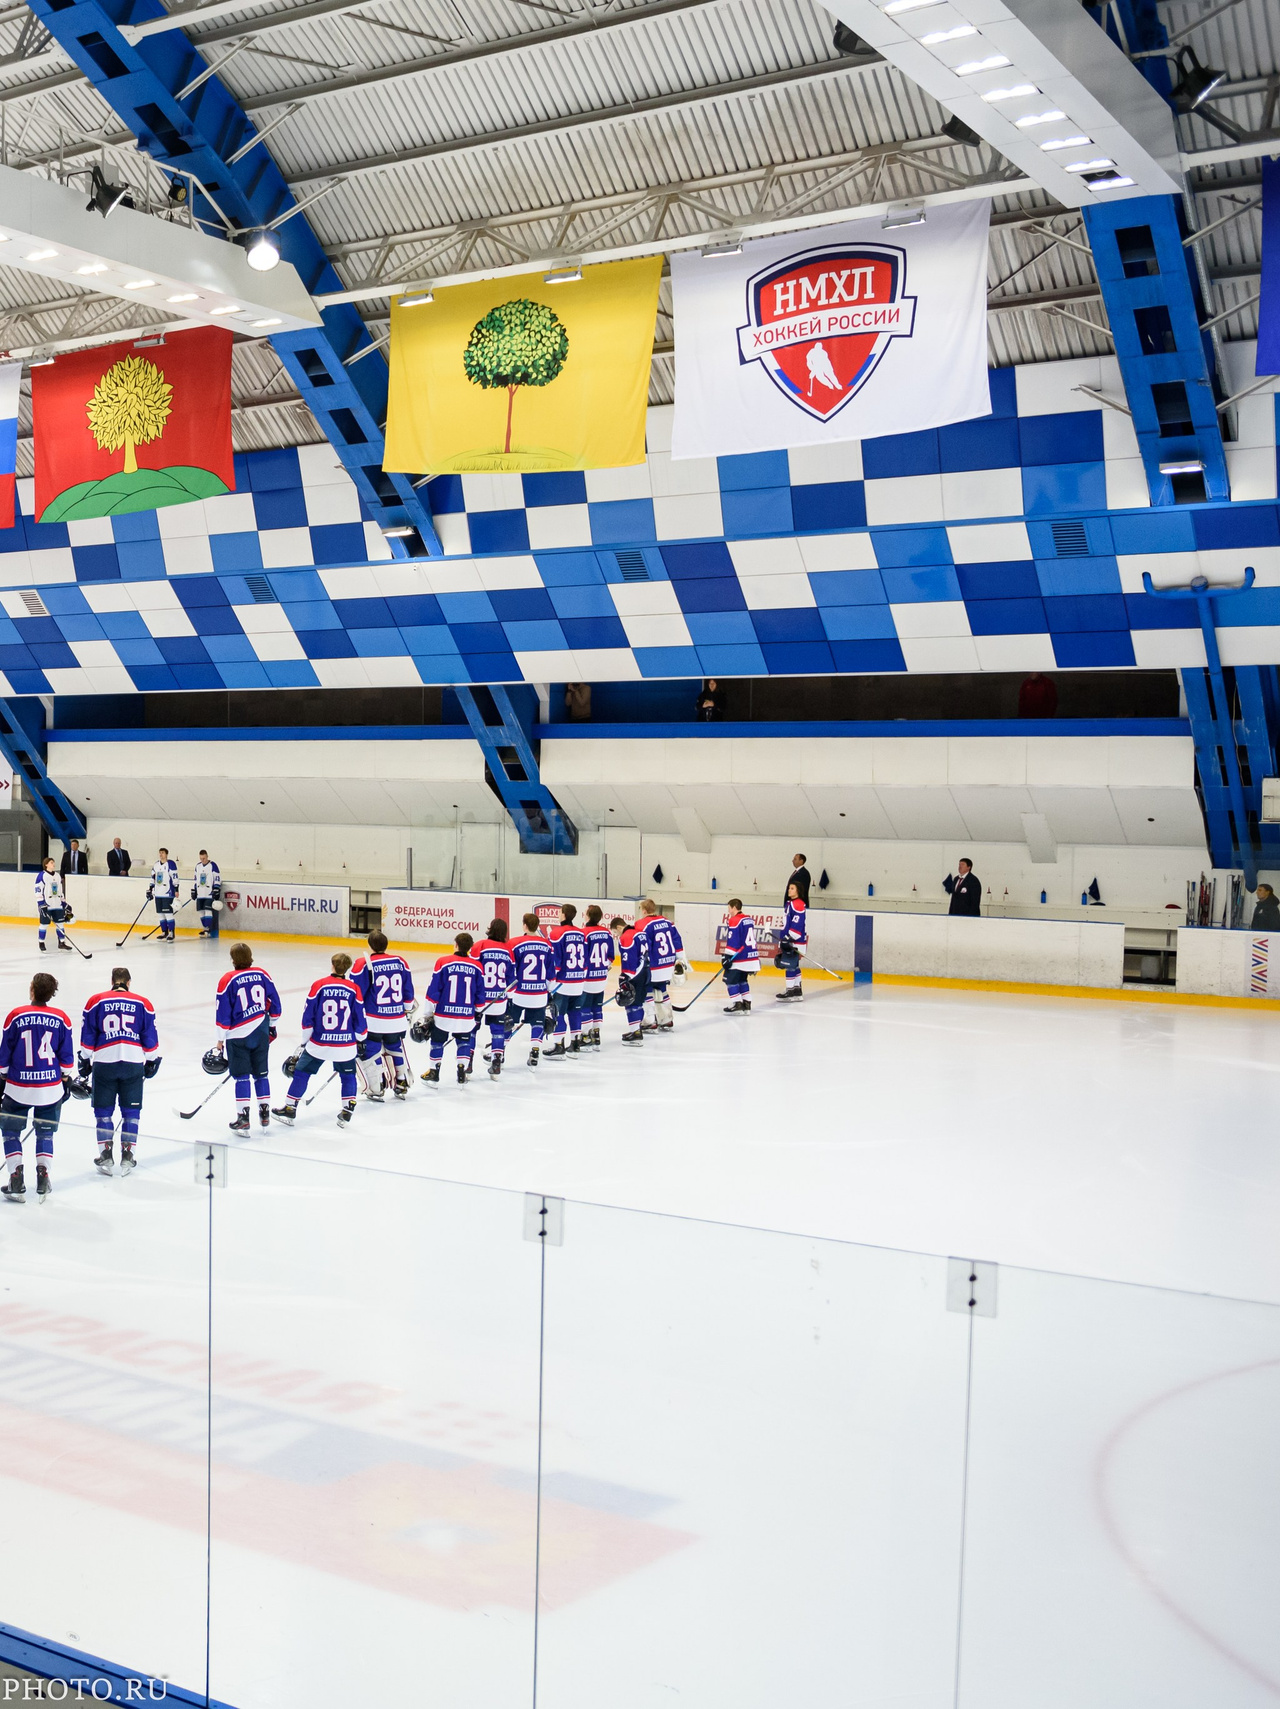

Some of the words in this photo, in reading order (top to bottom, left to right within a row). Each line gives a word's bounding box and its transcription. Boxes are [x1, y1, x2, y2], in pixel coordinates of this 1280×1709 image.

[773, 266, 875, 316] НМХЛ
[753, 316, 822, 348] ХОККЕЙ
[827, 307, 901, 333] РОССИИ
[246, 894, 339, 914] NMHL.FHR.RU
[394, 905, 454, 918] ФЕДЕРАЦИЯ
[394, 918, 434, 928] ХОККЕЯ
[436, 920, 480, 931] РОССИИ
[566, 943, 584, 969] 33
[590, 942, 609, 968] 40
[655, 930, 676, 956] 31
[483, 961, 507, 988] 89
[522, 954, 546, 980] 21
[565, 971, 585, 979] ЛИПЕЦ
[588, 970, 608, 978] ЛИПЕ
[237, 985, 266, 1012] 19
[376, 973, 403, 1004] 29
[448, 975, 472, 1004] 11
[484, 990, 507, 999] ИПЕЦ
[104, 1003, 137, 1014] БУРЦЕВ
[321, 1000, 352, 1031] 87
[21, 1030, 56, 1067] 14
[320, 1033, 353, 1042] ЛИПЕЦК
[19, 1069, 57, 1080] ЛИПЕЦК
